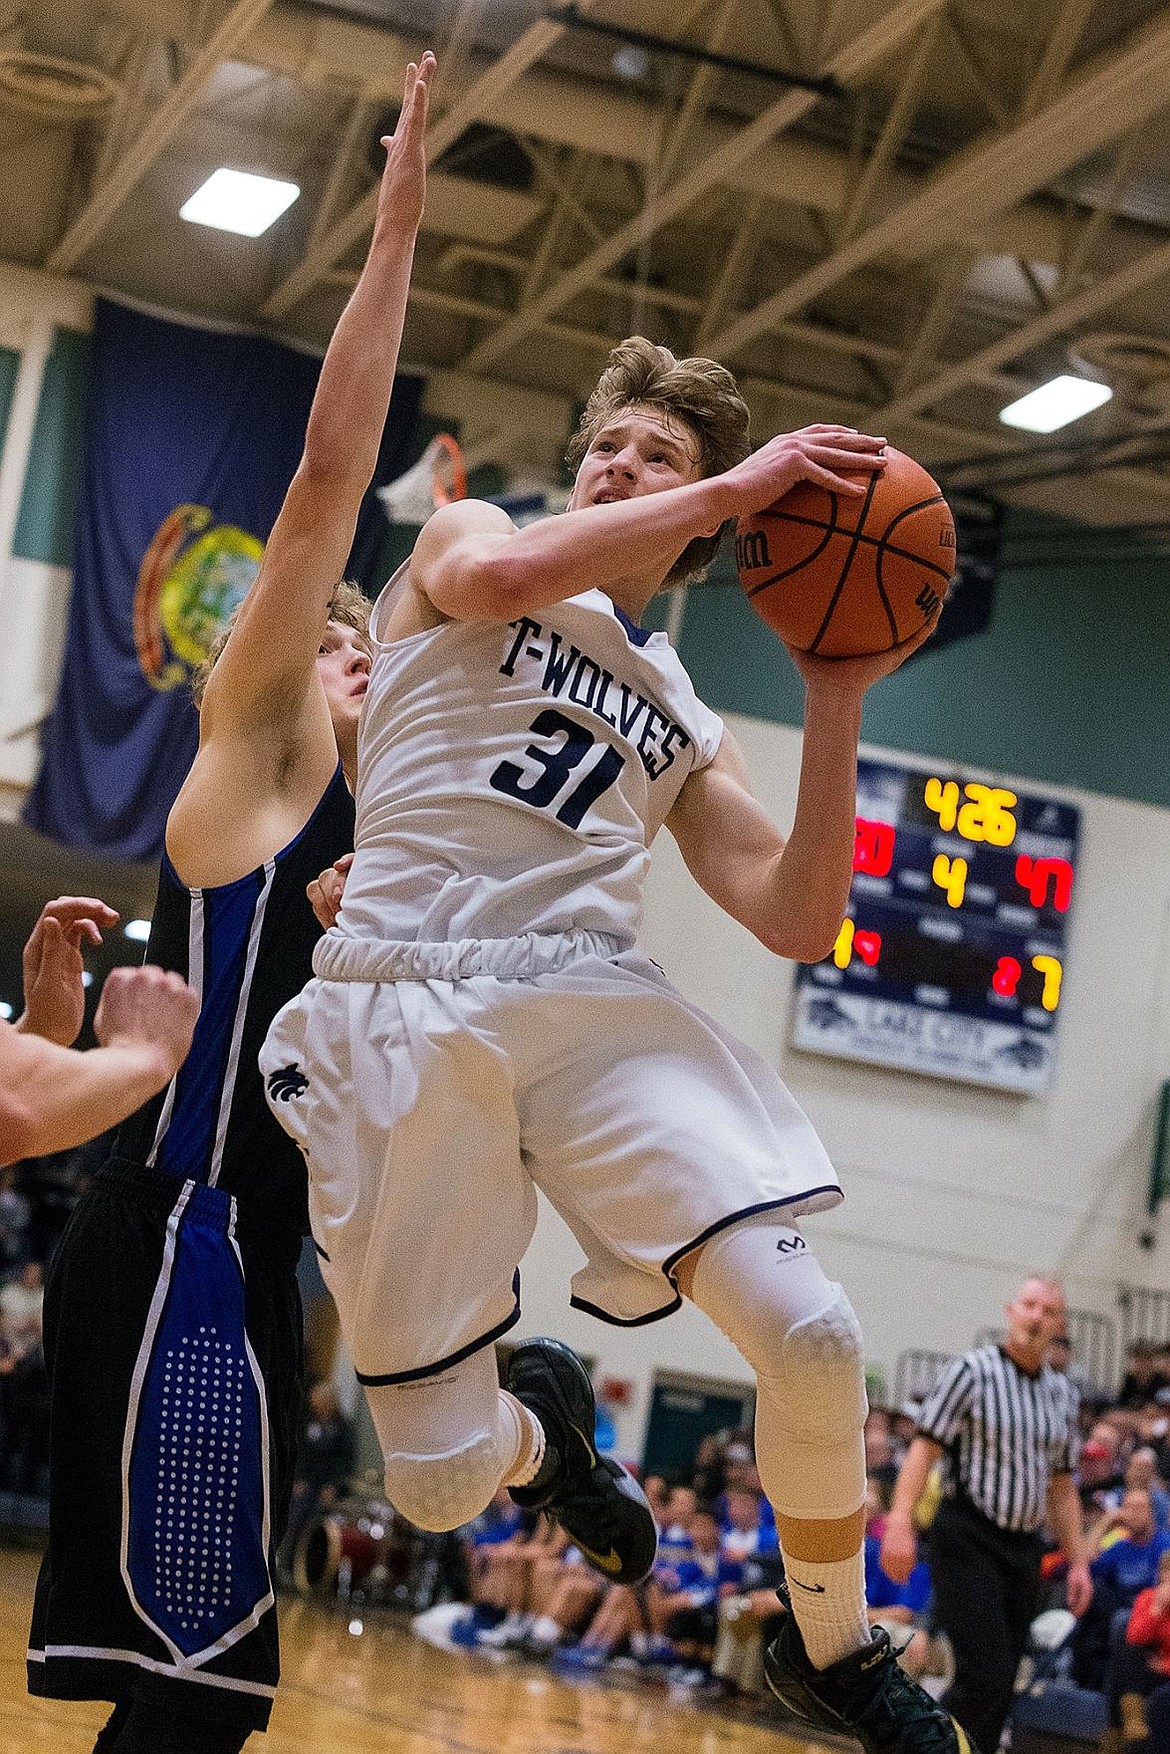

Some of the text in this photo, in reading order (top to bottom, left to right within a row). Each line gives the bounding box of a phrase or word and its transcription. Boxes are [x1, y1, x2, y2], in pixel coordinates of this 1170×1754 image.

[499, 617, 692, 781] T-WOLVES
[489, 709, 626, 830] 31
[932, 854, 968, 908] 4
[1015, 854, 1074, 912] 47
[1031, 954, 1063, 1012] 7
